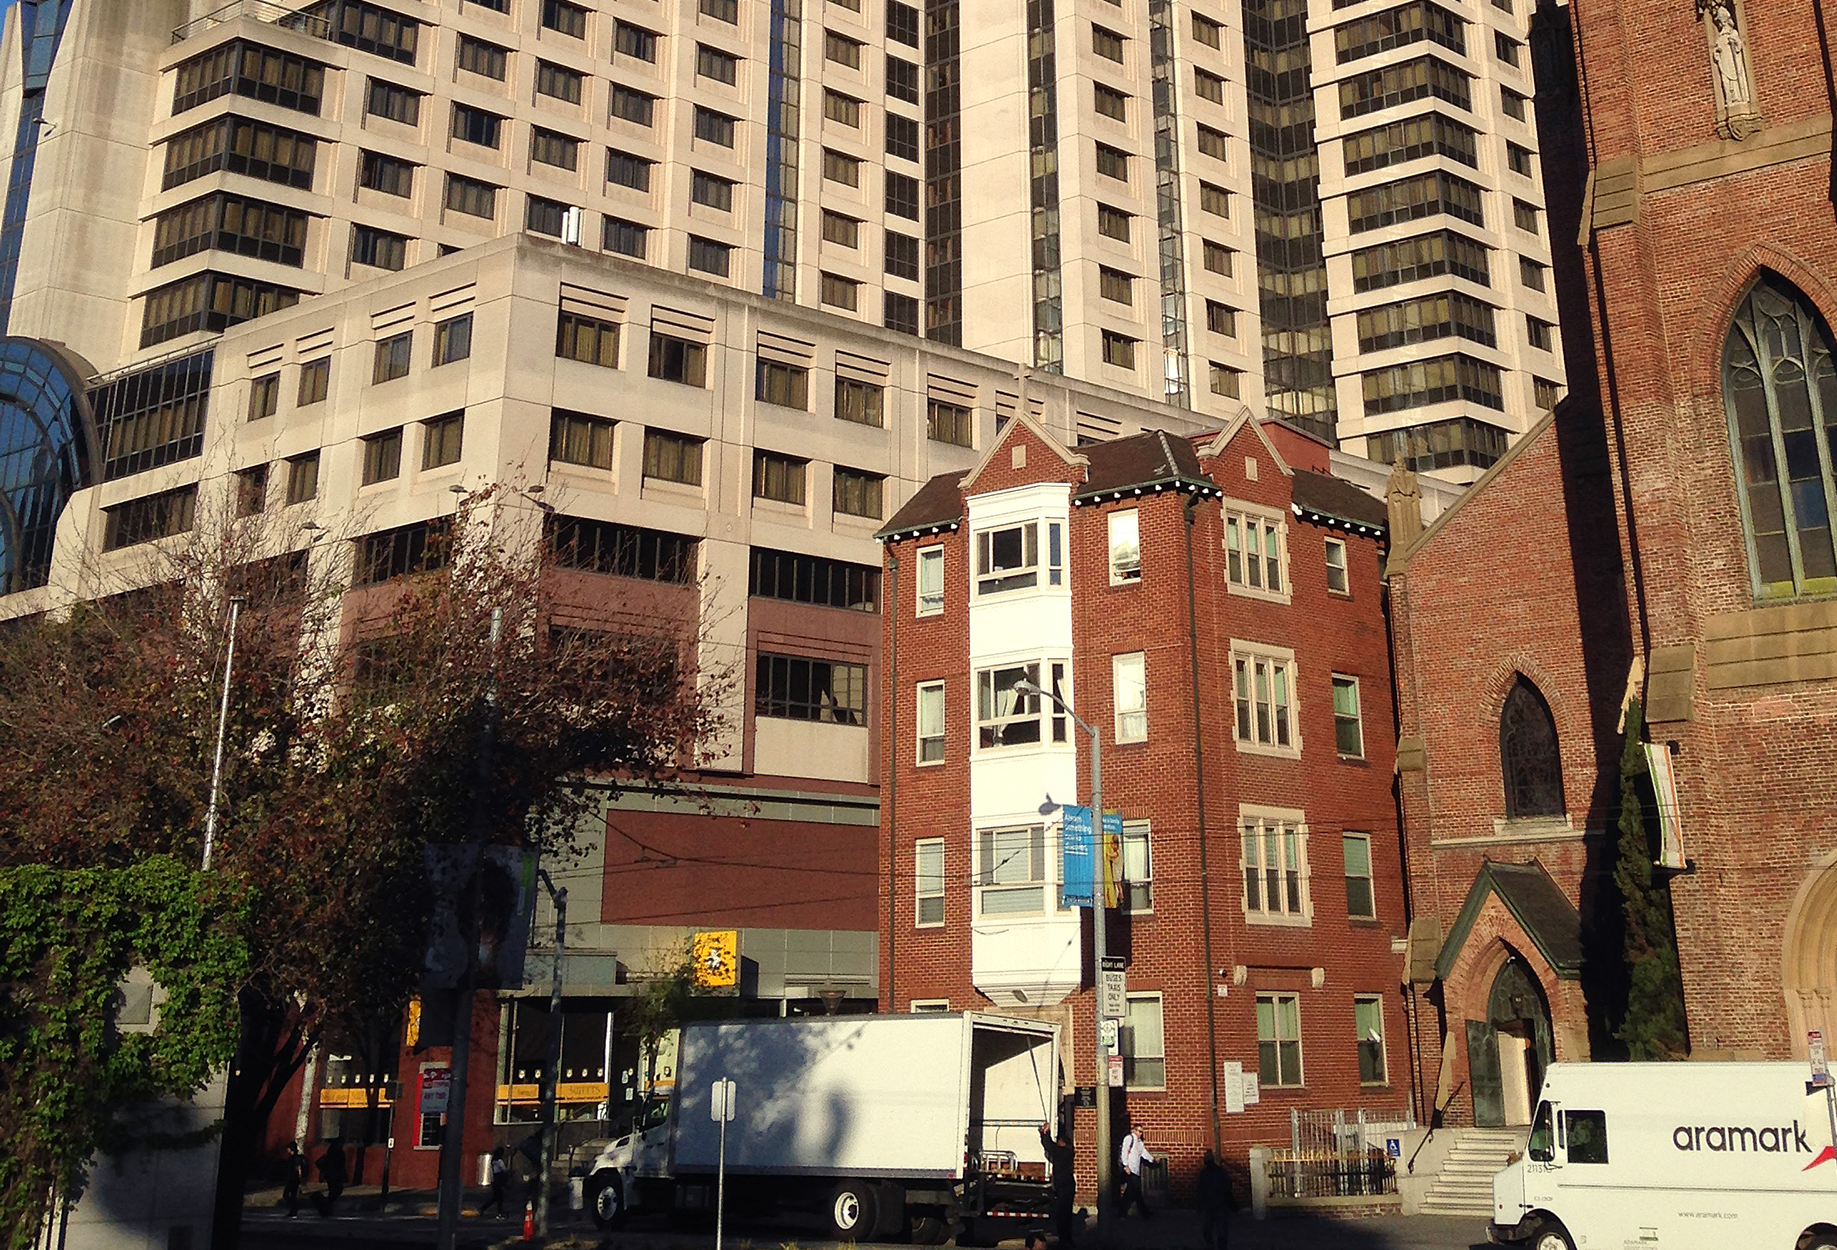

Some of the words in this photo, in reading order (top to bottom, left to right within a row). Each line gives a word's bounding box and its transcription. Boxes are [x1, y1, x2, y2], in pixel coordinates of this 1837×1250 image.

[1106, 974, 1122, 982] BUSES
[1107, 992, 1120, 1000] ONLY
[1672, 1119, 1813, 1153] aramark
[1677, 1211, 1739, 1220] www.aramark.com
